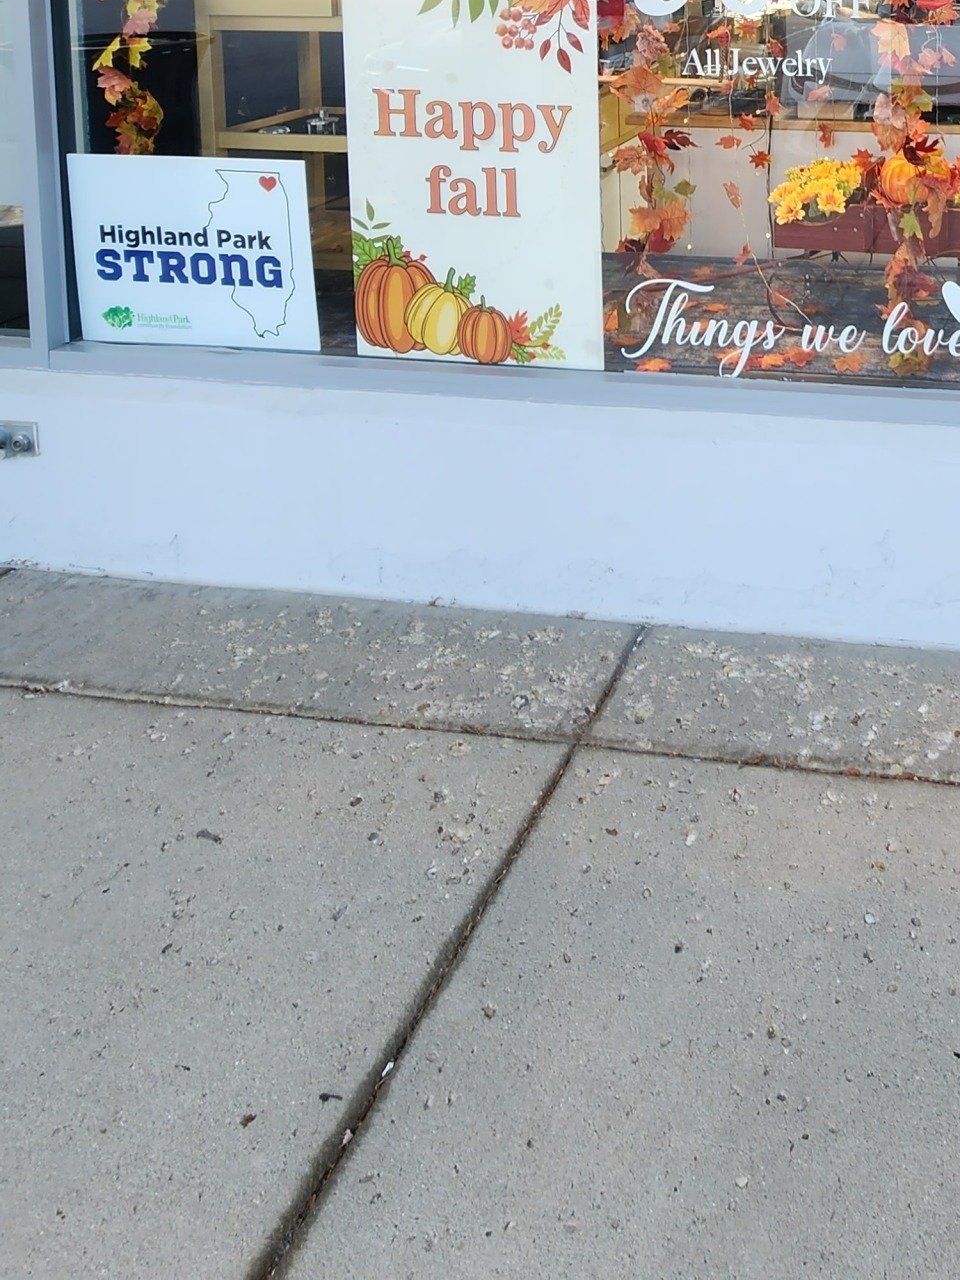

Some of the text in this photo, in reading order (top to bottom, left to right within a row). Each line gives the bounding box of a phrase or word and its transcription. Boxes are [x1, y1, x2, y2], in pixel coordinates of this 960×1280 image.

[681, 47, 833, 85] All Jewelry
[372, 88, 573, 154] Happy
[425, 164, 521, 218] fall
[99, 224, 273, 251] Highland Park
[620, 278, 785, 378] Things
[801, 320, 867, 355] we
